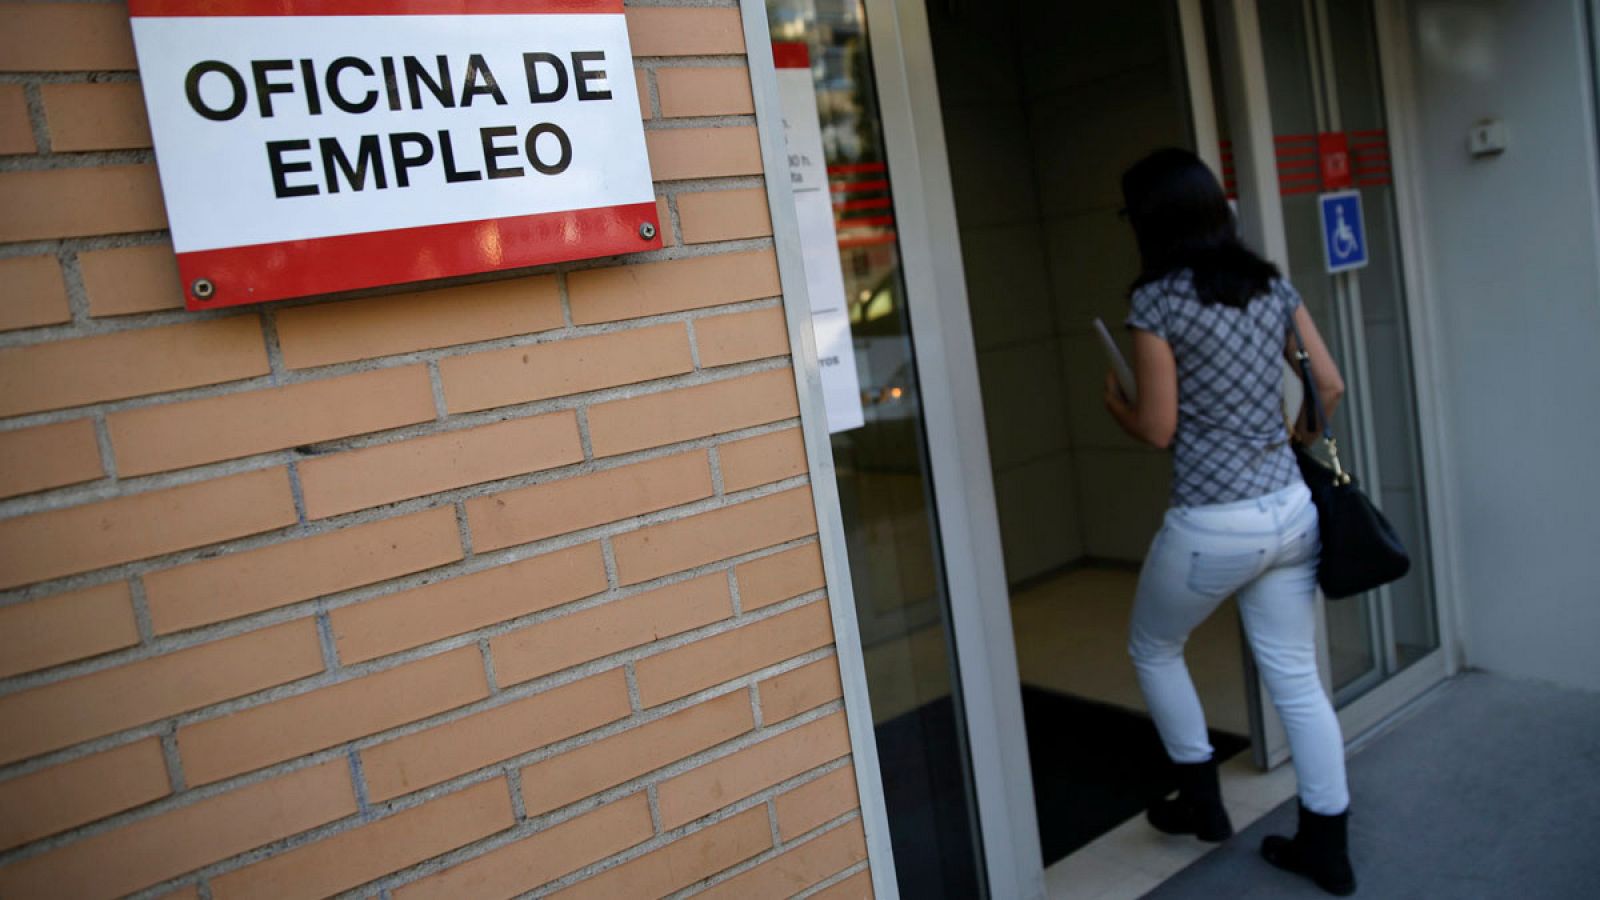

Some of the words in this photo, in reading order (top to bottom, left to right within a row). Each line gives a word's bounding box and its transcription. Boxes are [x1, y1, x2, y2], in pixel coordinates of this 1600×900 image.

[185, 53, 508, 121] OFICINA
[523, 51, 613, 104] DE
[266, 122, 573, 198] EMPLEO
